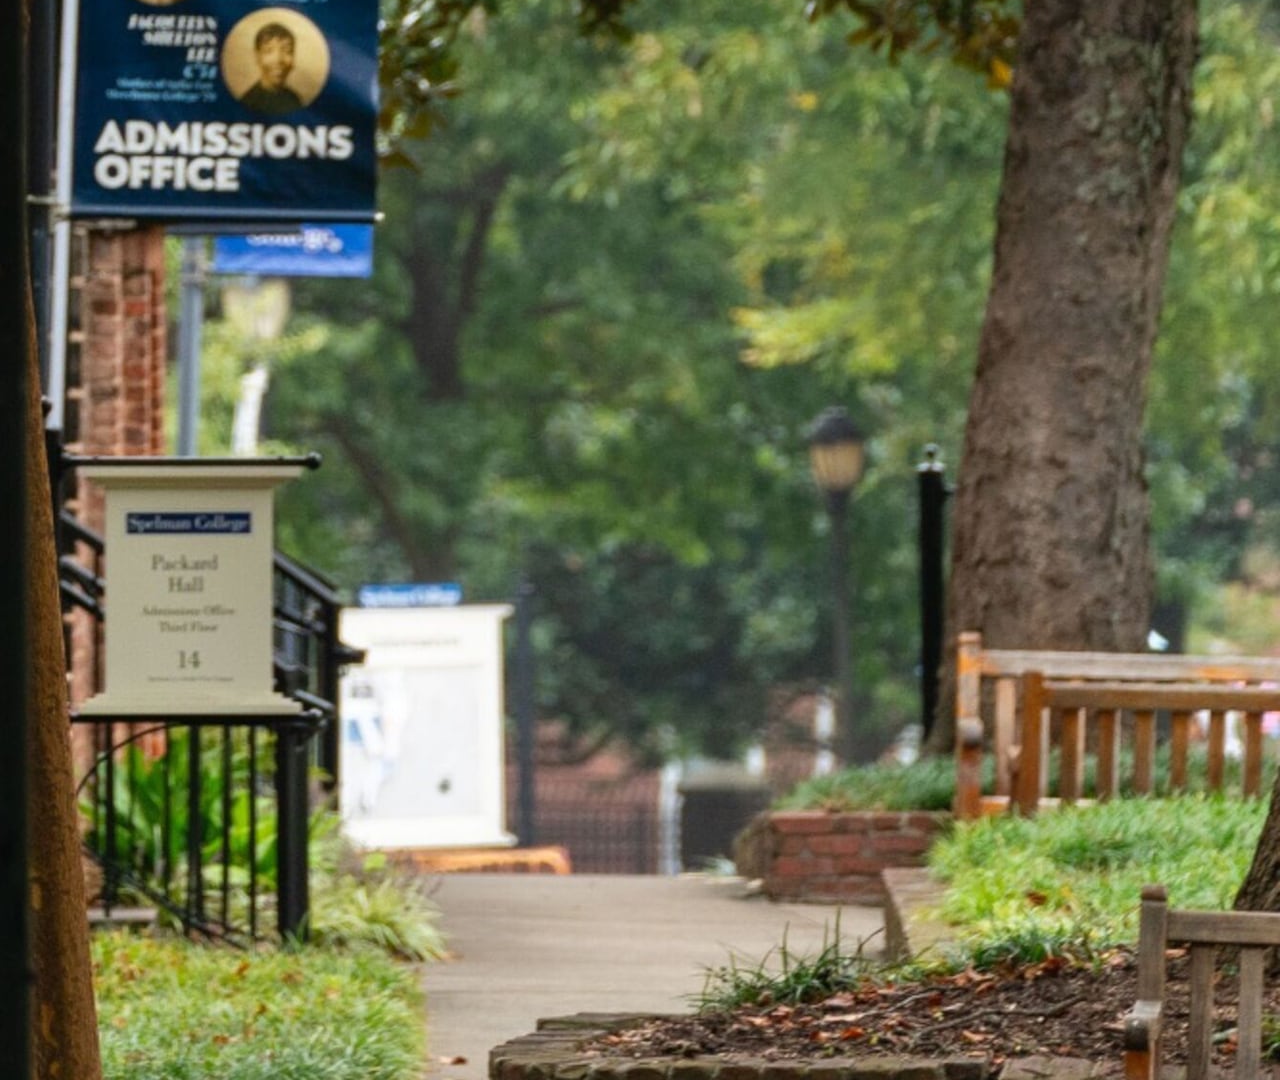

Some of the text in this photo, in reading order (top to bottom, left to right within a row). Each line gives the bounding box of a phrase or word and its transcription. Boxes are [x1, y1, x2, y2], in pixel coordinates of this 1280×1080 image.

[94, 120, 354, 160] ADMISSIONS
[94, 154, 241, 191] OFFICE
[129, 514, 248, 533] Spelman College
[151, 553, 219, 571] Packard
[167, 575, 204, 593] Hall
[178, 650, 202, 669] 14
